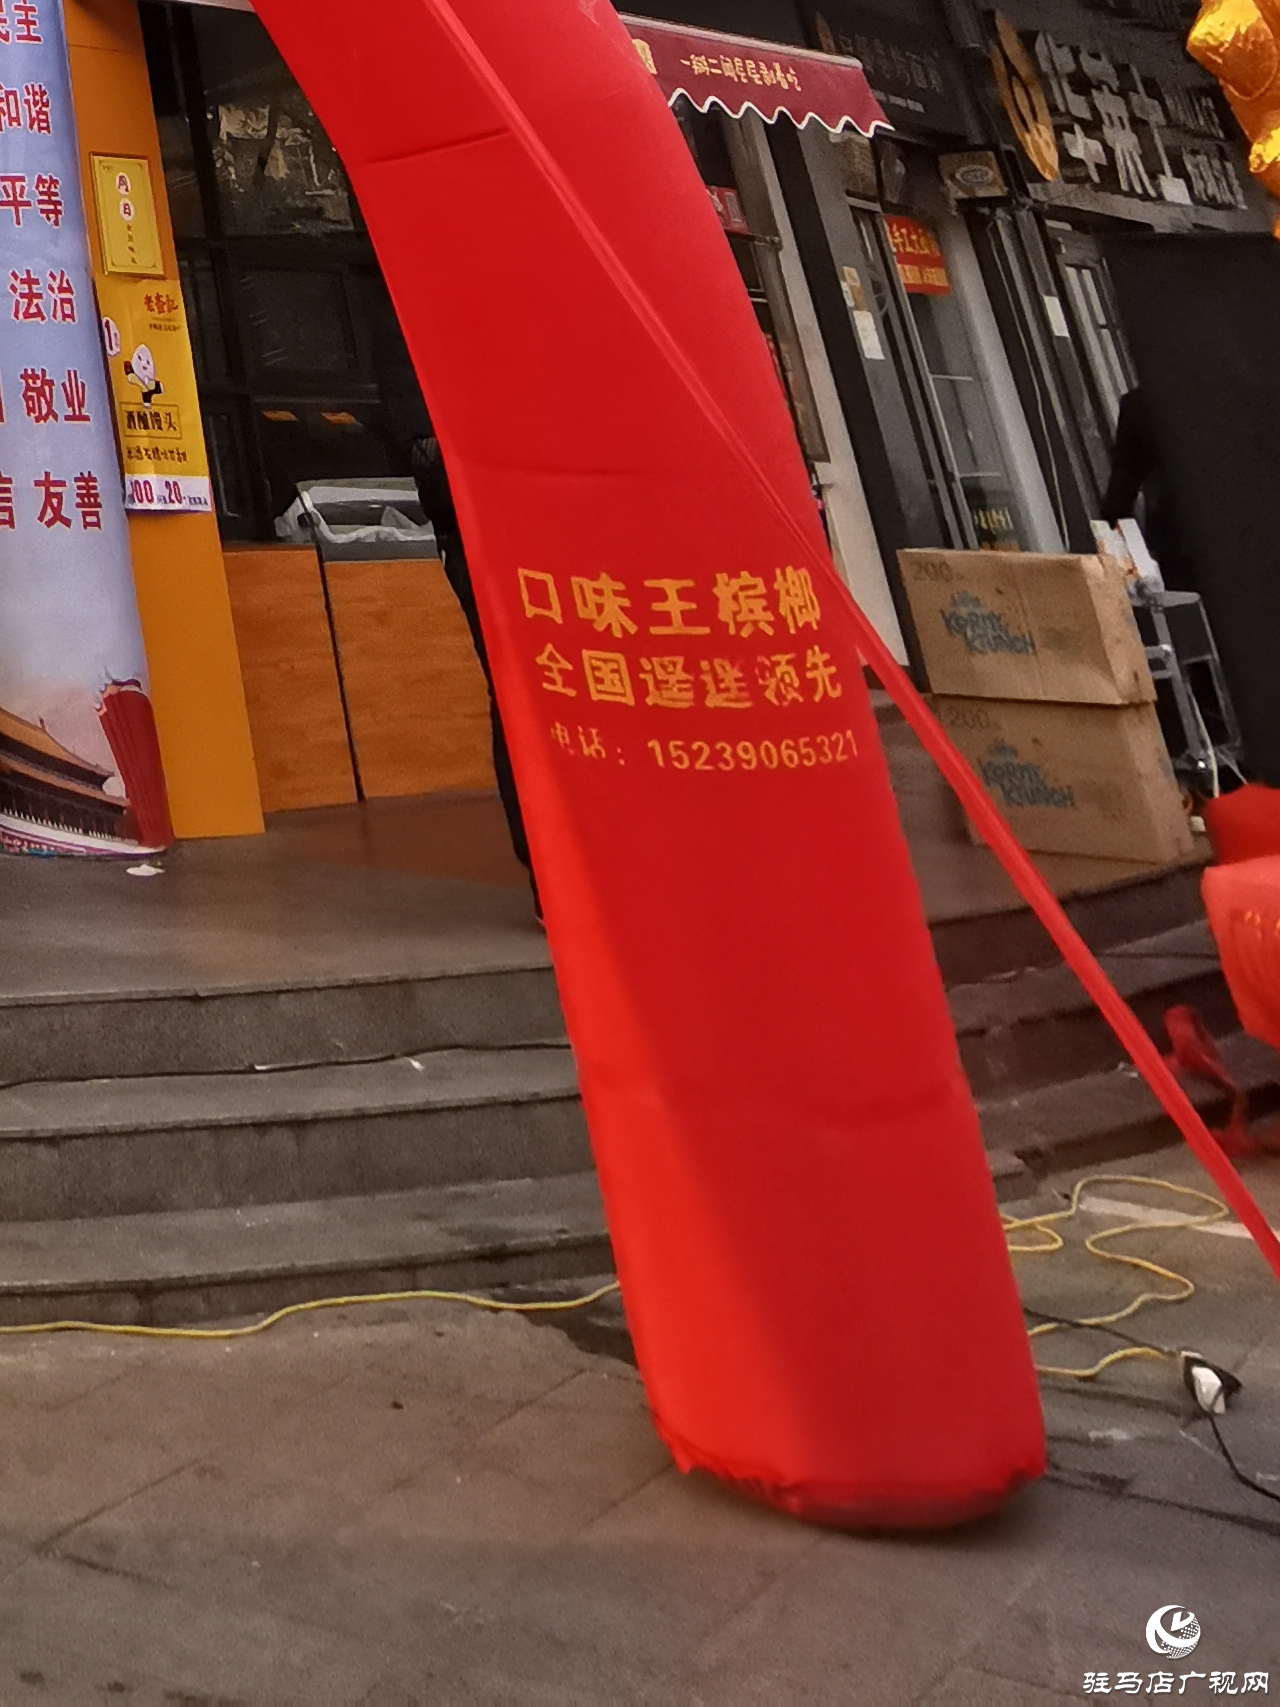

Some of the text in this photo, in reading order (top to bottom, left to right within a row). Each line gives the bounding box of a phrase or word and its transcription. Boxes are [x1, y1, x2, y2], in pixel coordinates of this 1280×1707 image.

[8, 270, 79, 324] 法治
[20, 367, 92, 424] 敬业
[33, 470, 104, 531] 友善
[517, 564, 822, 639] 口味王槟榔
[646, 728, 859, 771] 15239065321
